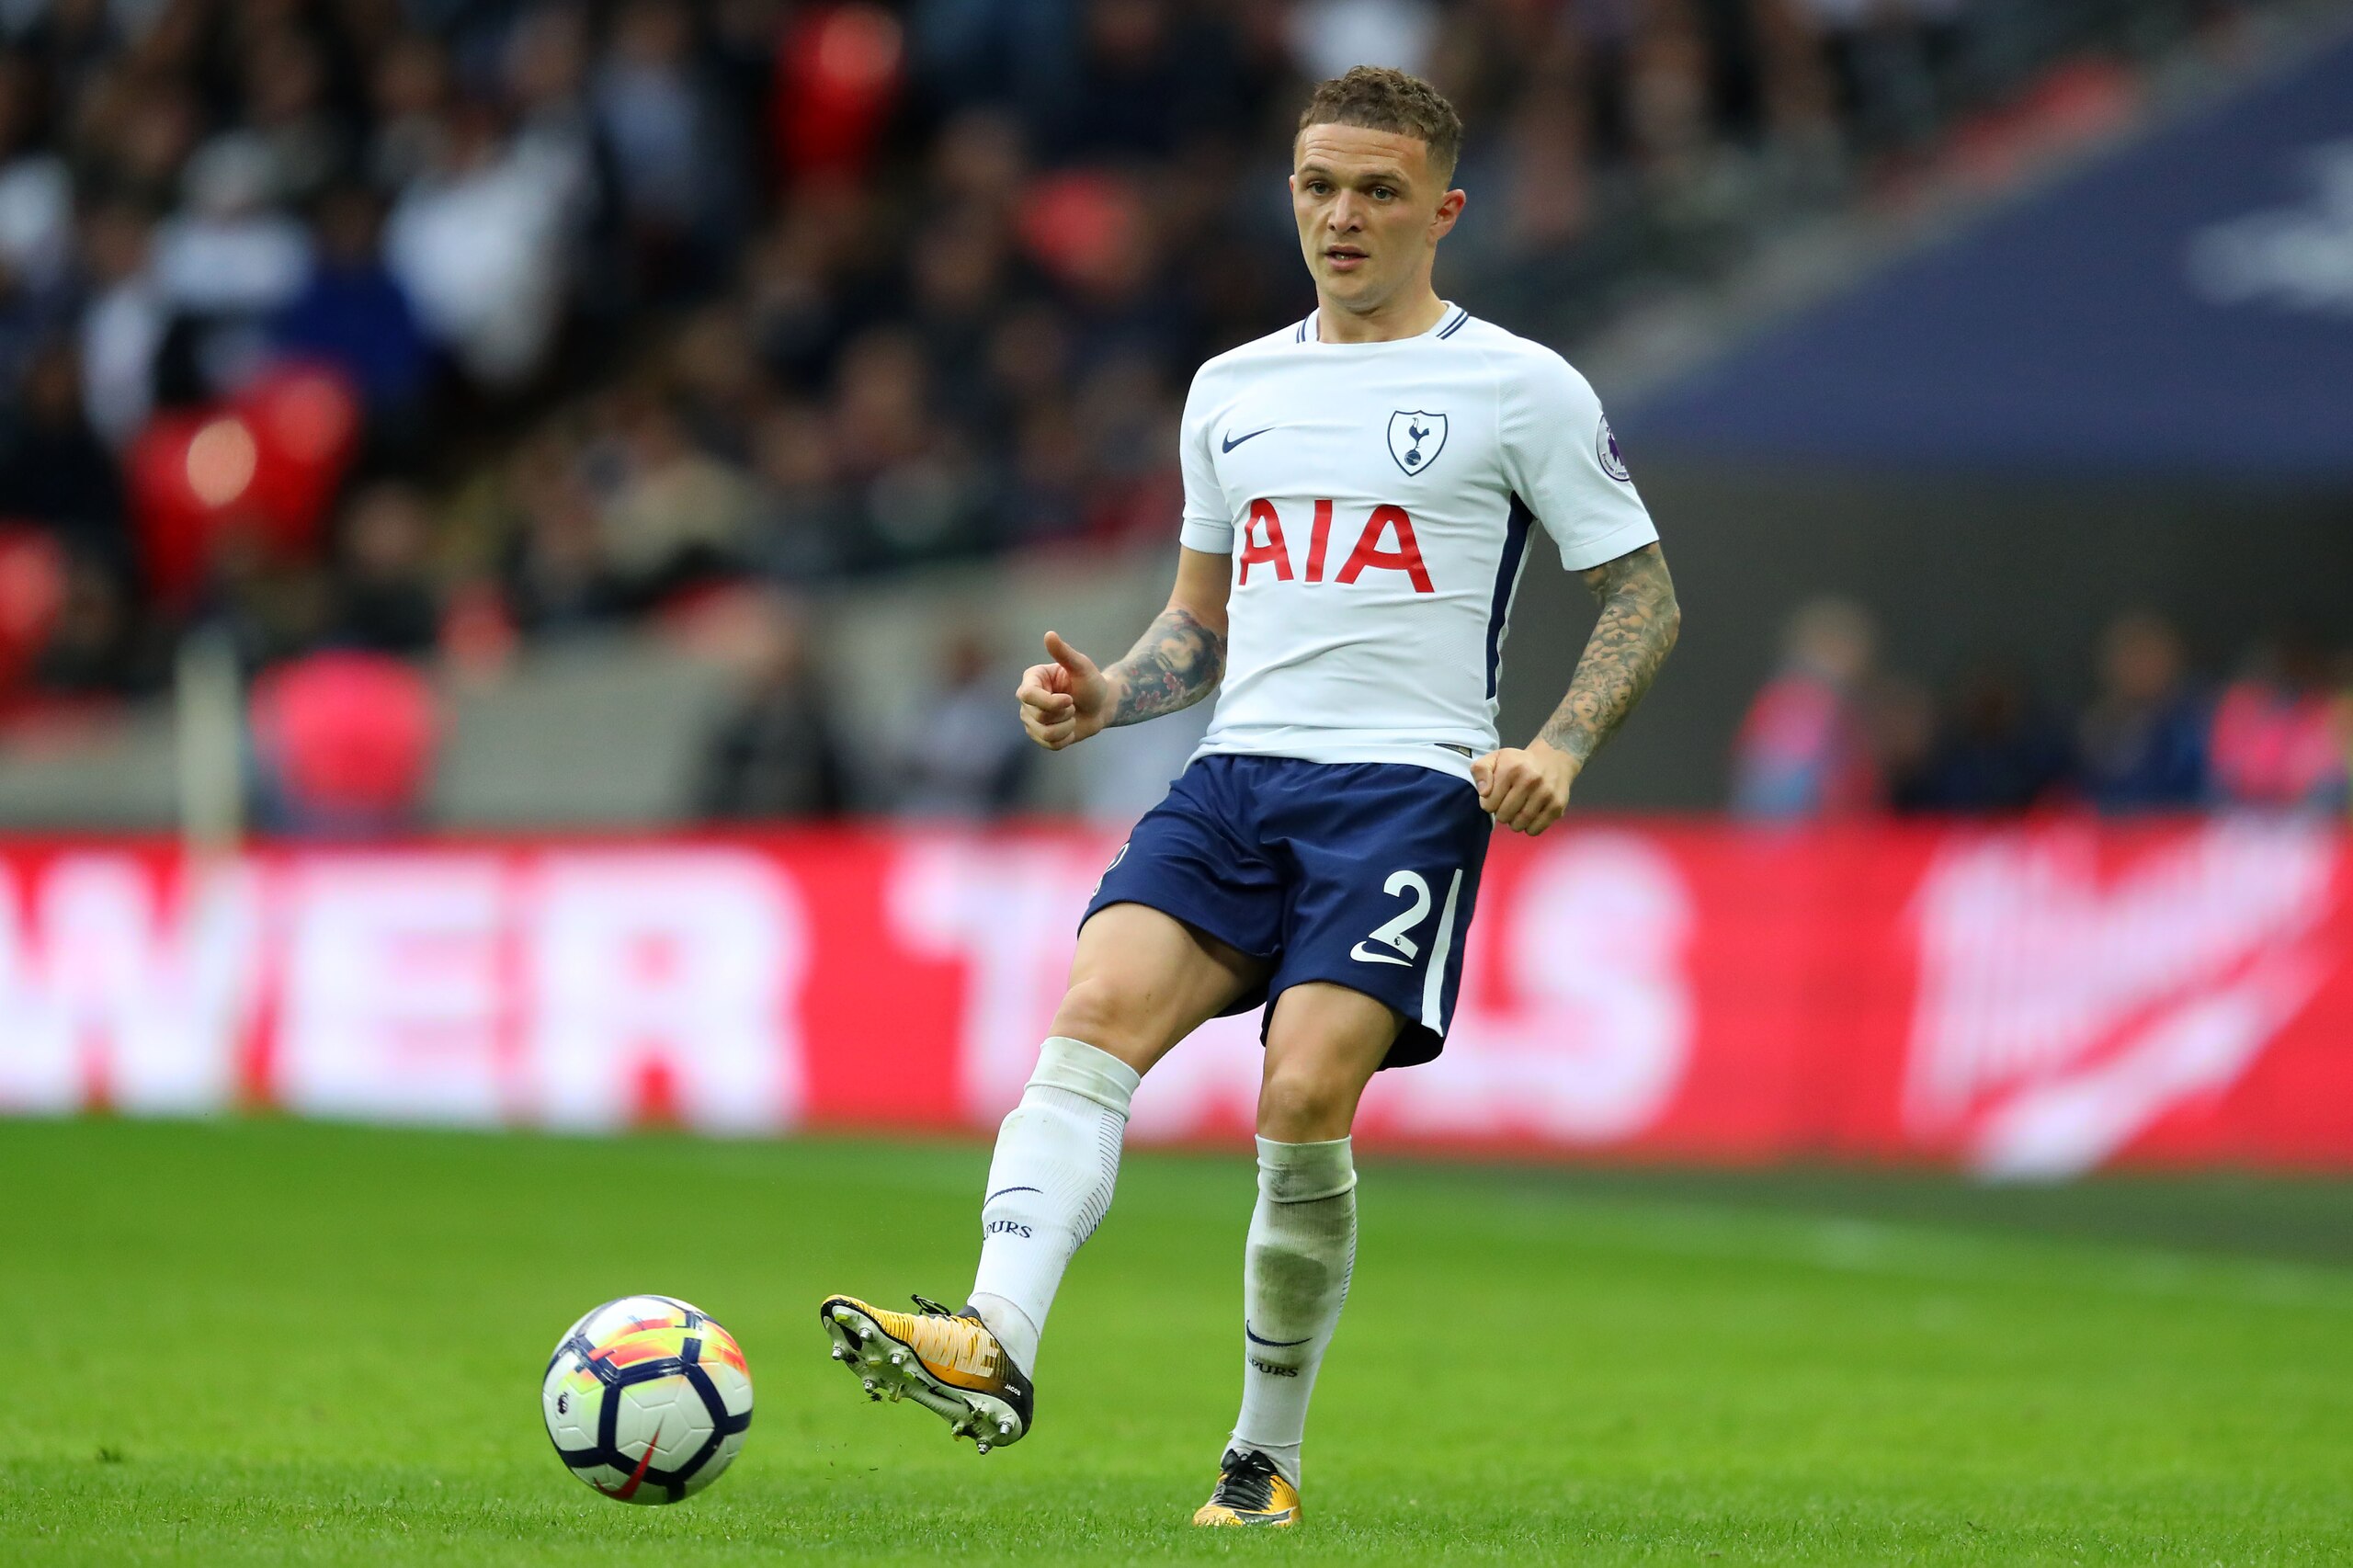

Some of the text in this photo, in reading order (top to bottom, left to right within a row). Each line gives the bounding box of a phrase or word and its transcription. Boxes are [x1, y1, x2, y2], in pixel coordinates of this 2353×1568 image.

[1238, 498, 1436, 593] AIA
[1368, 869, 1432, 960] 2
[983, 1220, 1032, 1241] PURS
